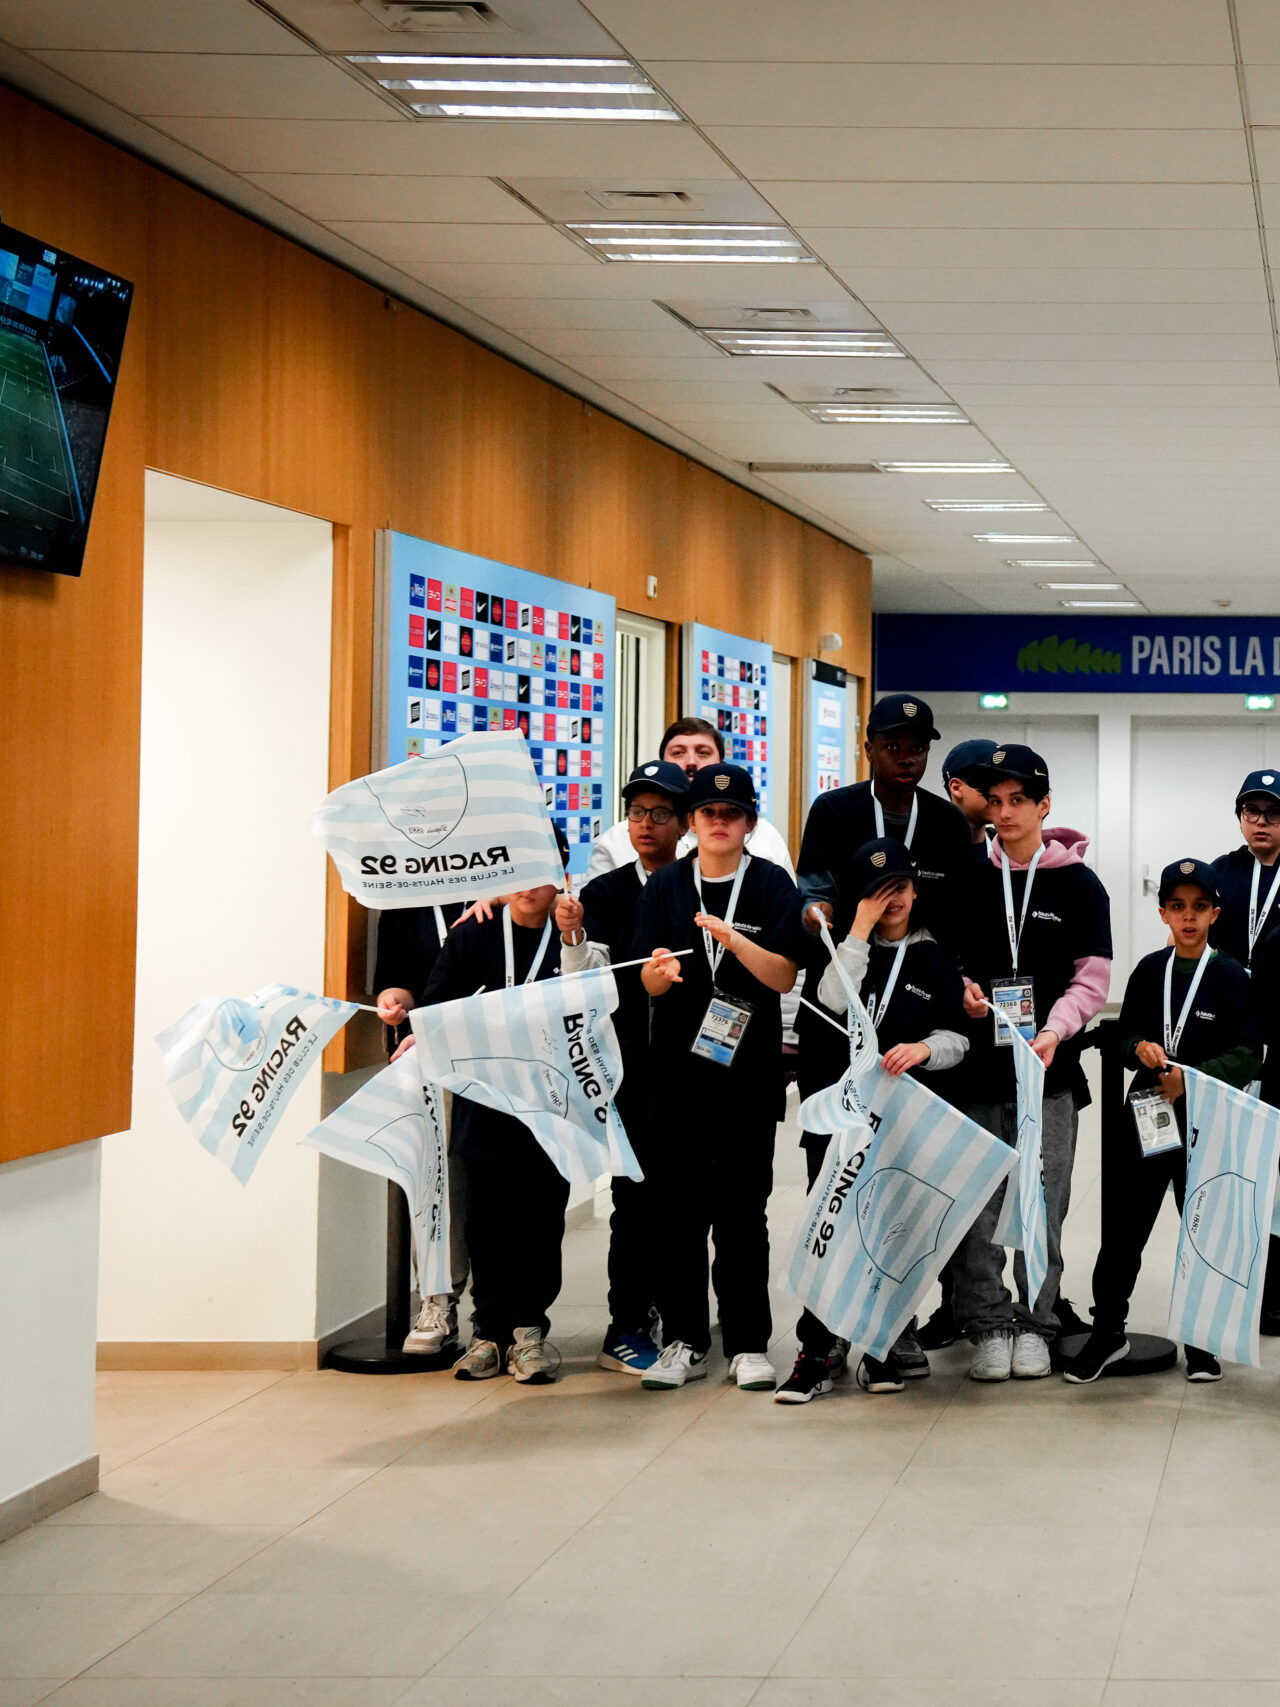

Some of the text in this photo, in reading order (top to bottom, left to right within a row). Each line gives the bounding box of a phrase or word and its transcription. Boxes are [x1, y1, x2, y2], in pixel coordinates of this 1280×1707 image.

[1131, 635, 1221, 676] PARIS
[1228, 635, 1267, 676] LA
[829, 1111, 883, 1215] RCING
[812, 1221, 834, 1259] 92
